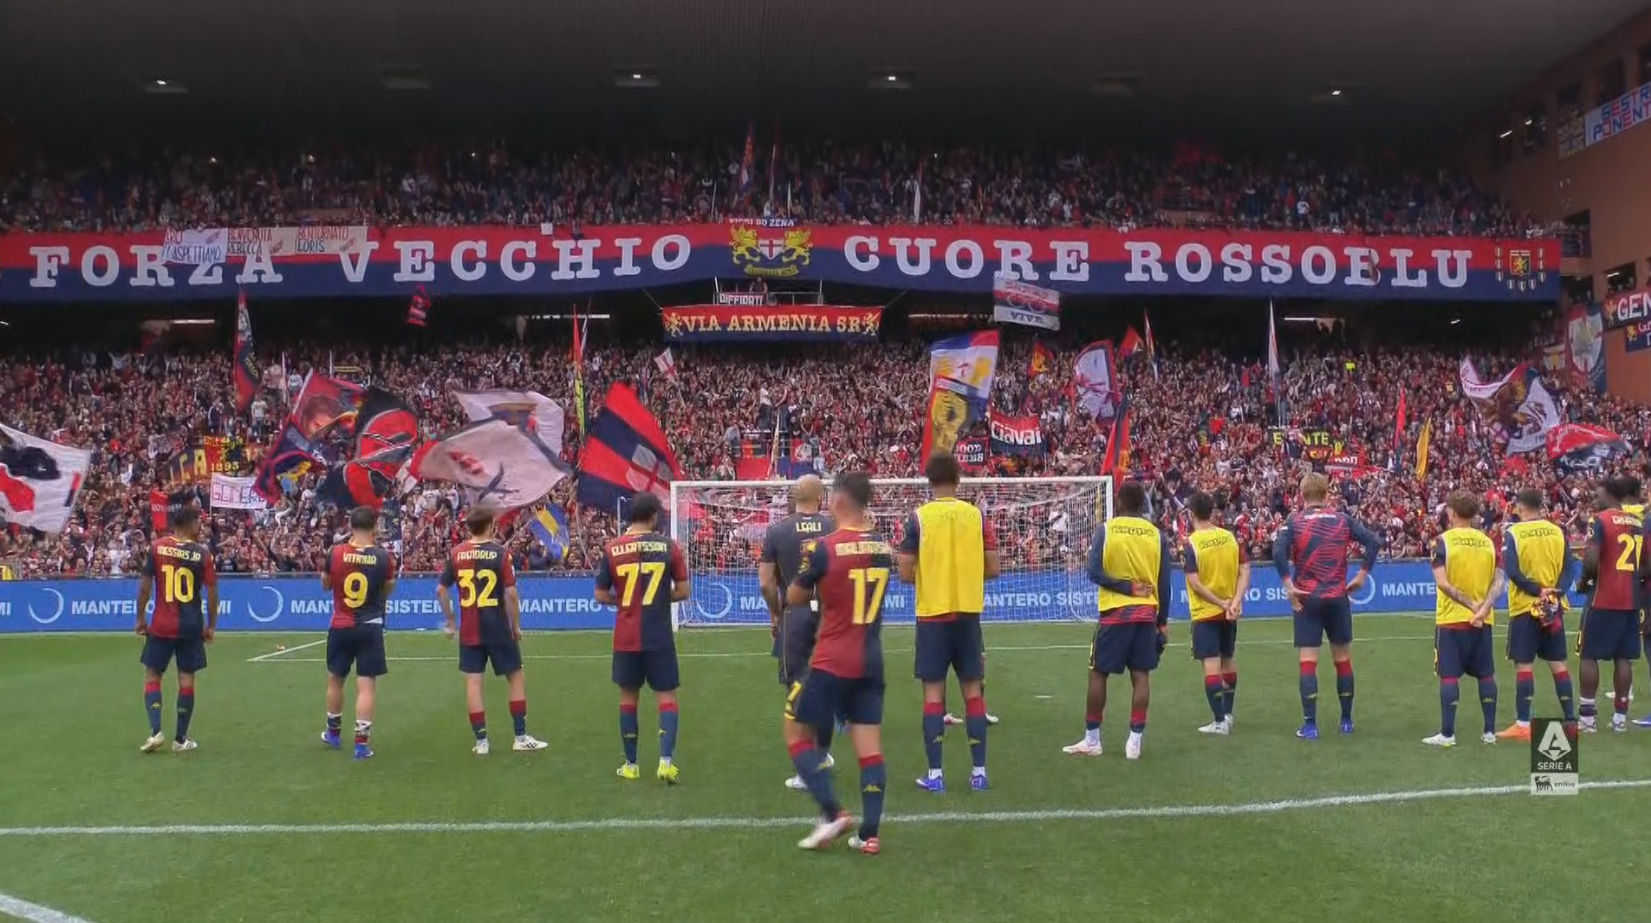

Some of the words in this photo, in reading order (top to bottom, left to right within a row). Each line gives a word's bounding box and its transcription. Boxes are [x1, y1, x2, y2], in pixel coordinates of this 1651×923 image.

[29, 245, 283, 287] FORZA
[339, 234, 691, 282] VECCHIO
[843, 236, 1090, 282] CUORE
[1124, 241, 1472, 287] ROSSOBLU
[683, 315, 722, 333] VIA
[727, 314, 831, 332] ARMENIA
[162, 564, 195, 604] 10
[343, 571, 369, 609] 9
[458, 568, 499, 608] 32
[616, 561, 666, 607] 77
[847, 566, 890, 625] 17
[984, 592, 1051, 606] ANTERO
[1382, 582, 1436, 597] MANTE
